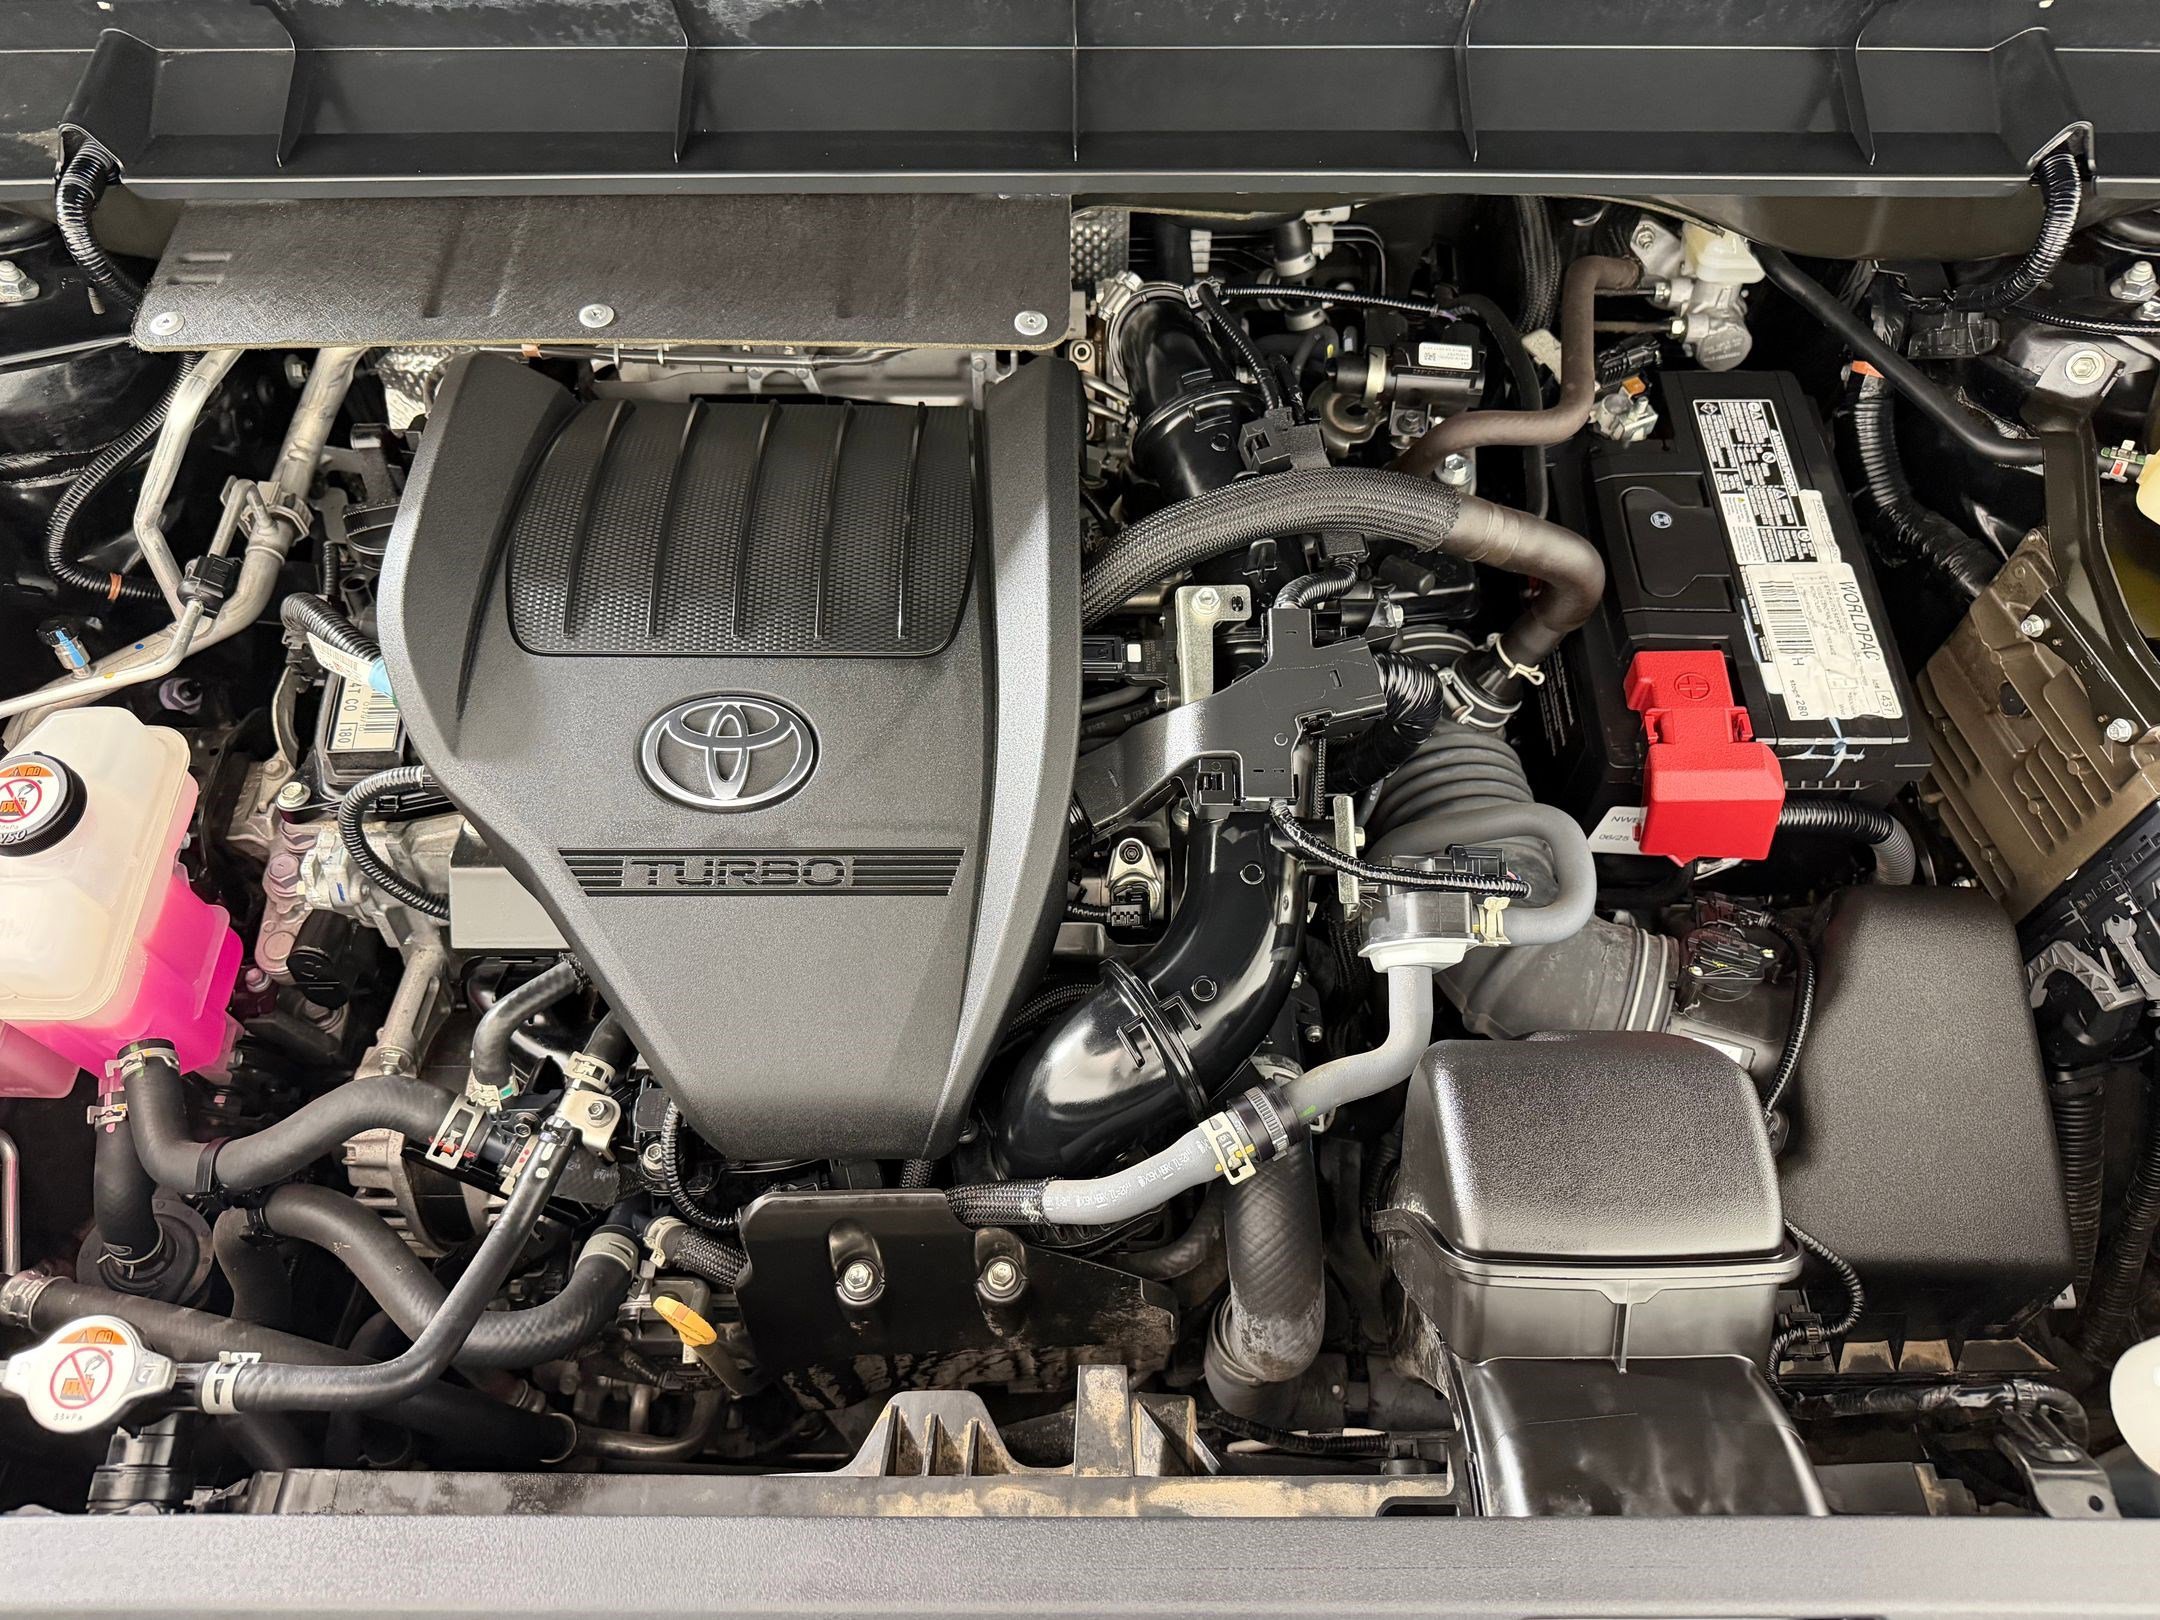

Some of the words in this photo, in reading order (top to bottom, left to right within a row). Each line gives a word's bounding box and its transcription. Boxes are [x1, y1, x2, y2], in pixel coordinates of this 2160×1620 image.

[1839, 581, 1880, 661] WORLDPAC
[1792, 657, 1805, 666] H
[1796, 700, 1809, 717] 280
[1882, 694, 1895, 714] 437
[337, 727, 353, 744] 180
[629, 857, 847, 887] TURBO
